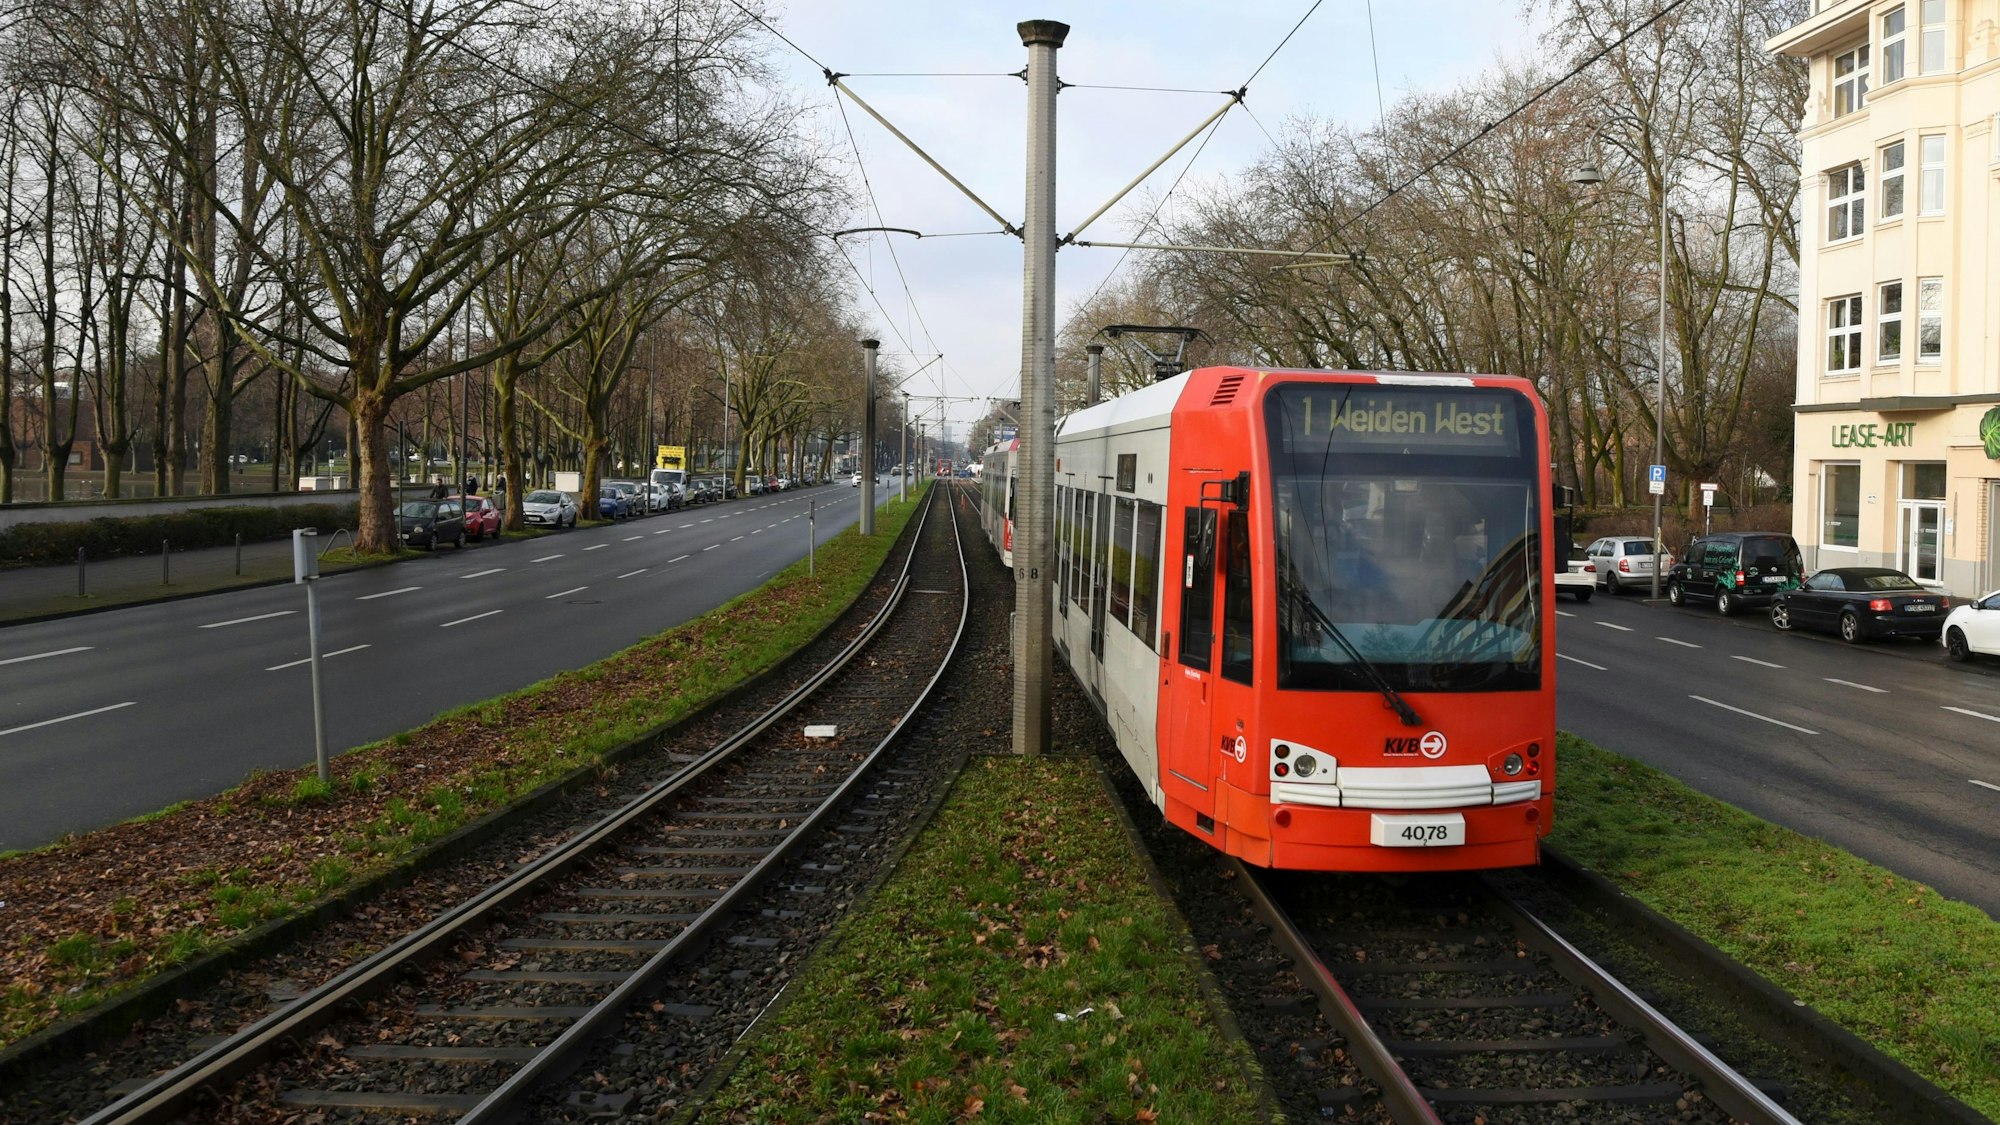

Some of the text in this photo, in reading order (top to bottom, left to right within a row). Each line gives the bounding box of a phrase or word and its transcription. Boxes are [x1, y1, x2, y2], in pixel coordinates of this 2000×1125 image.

[1303, 396, 1504, 435] 1 Weiden West
[1832, 422, 1917, 447] LEASE-ART
[1220, 735, 1236, 754] KVB
[1384, 737, 1420, 753] KVB
[1401, 825, 1448, 840] 4078
